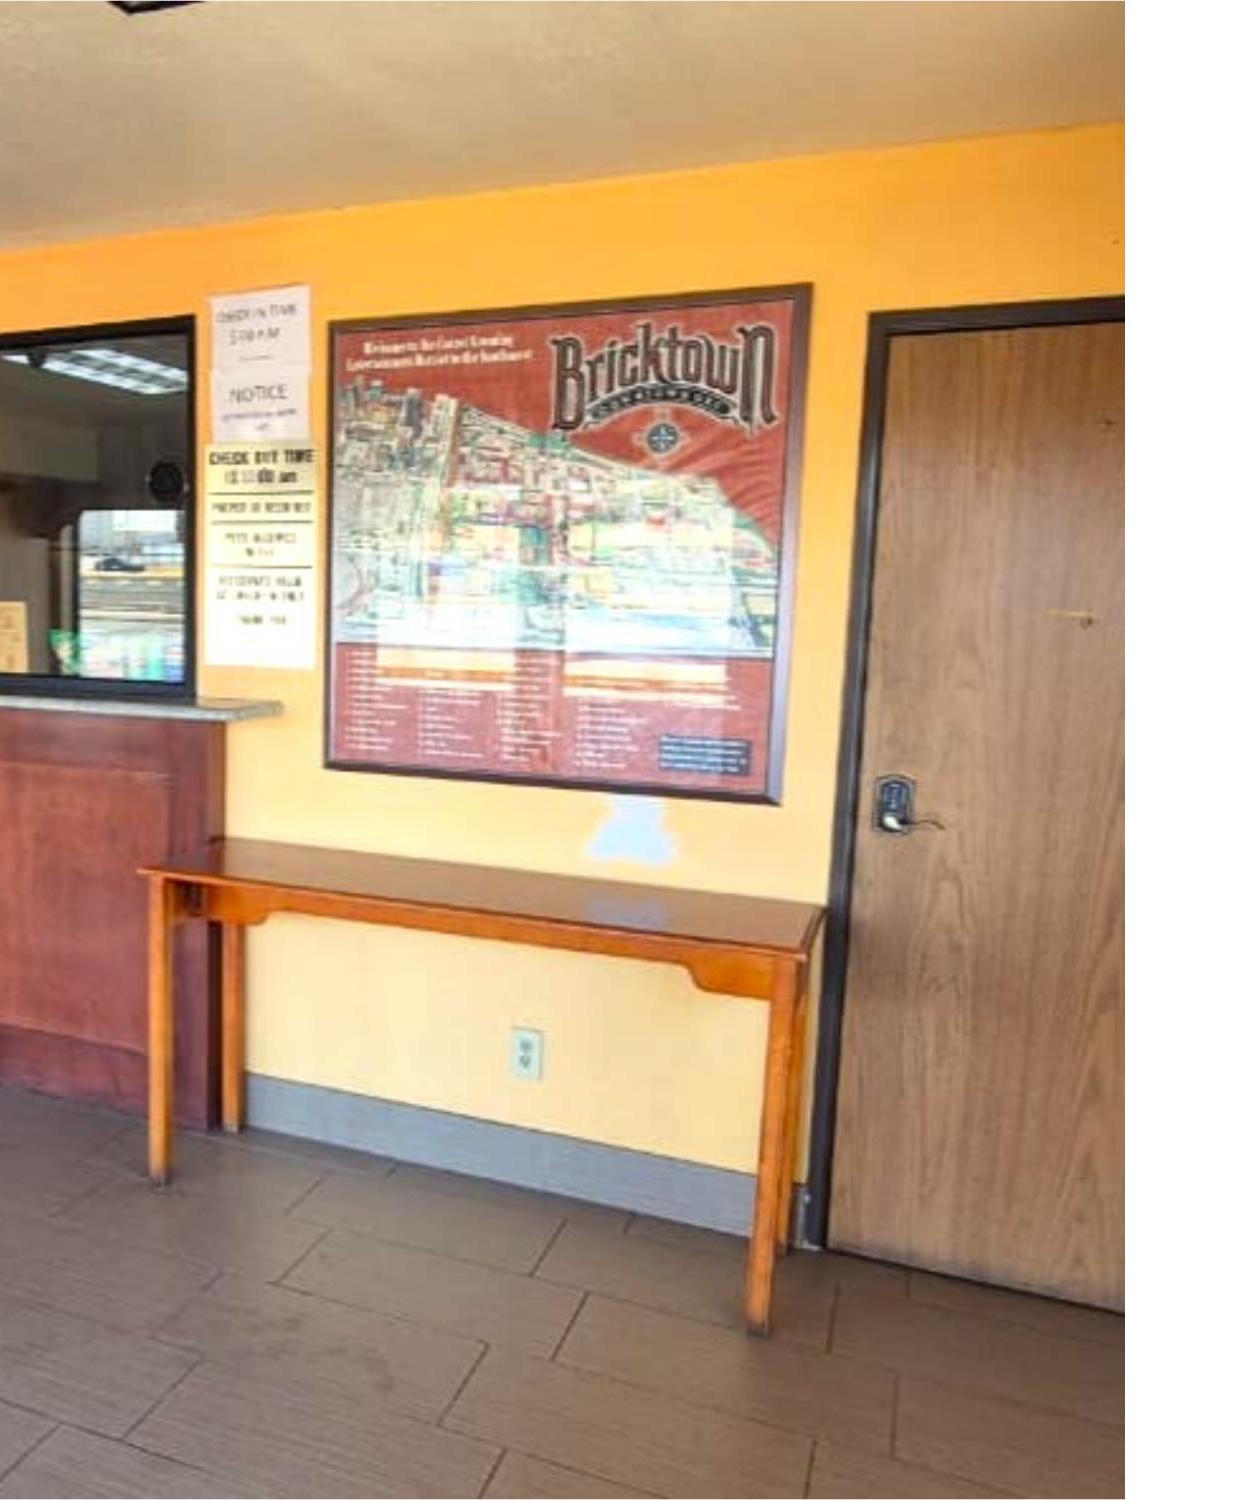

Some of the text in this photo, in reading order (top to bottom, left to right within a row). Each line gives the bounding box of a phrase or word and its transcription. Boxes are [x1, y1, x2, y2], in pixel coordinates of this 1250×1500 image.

[549, 322, 779, 430] Bricktown
[229, 383, 288, 403] NOTICE
[209, 447, 314, 465] CHECK OUT TIME
